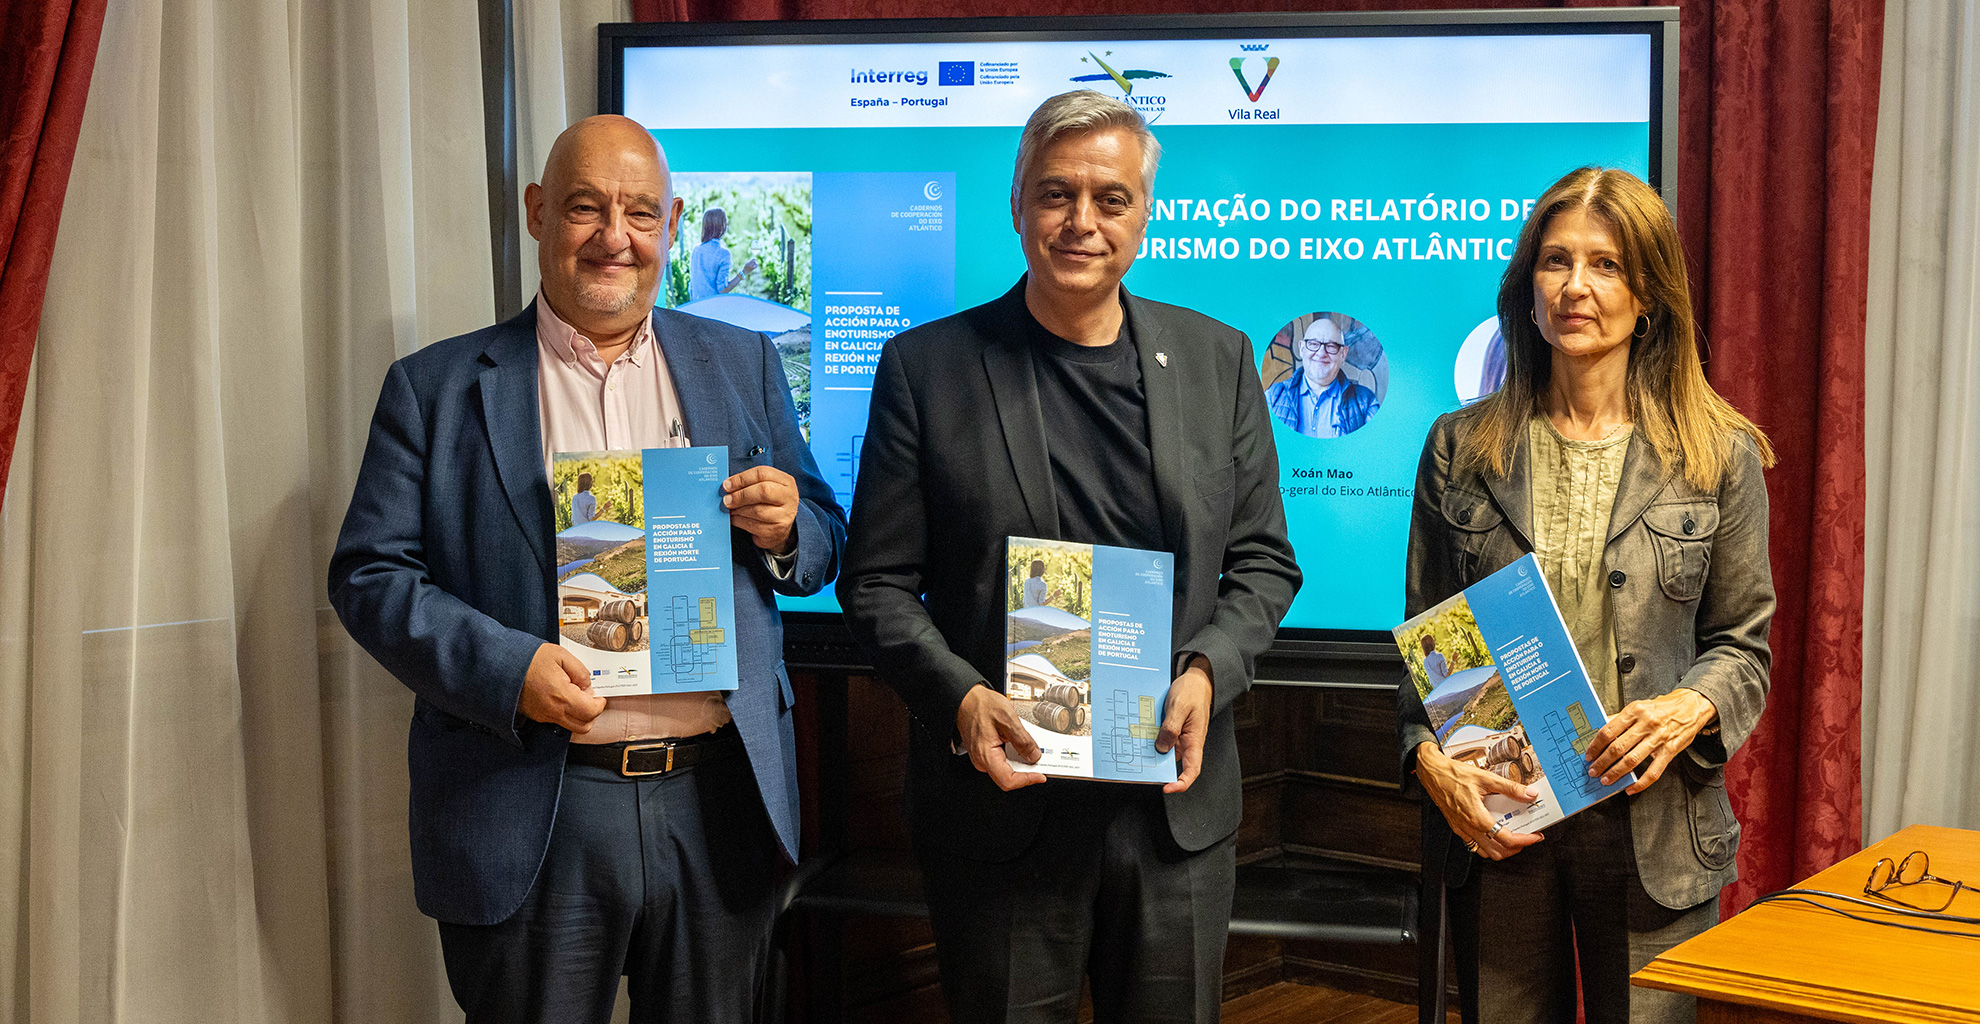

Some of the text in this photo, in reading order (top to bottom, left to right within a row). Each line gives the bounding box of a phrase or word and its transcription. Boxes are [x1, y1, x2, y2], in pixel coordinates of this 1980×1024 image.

[851, 68, 928, 86] Interreg
[851, 97, 890, 108] España
[901, 97, 948, 108] Portugal
[1228, 108, 1280, 120] Vila Real
[1281, 199, 1321, 221] DO
[1331, 192, 1491, 221] RELATÓRIO
[1249, 237, 1290, 260] DO
[1300, 237, 1364, 260] EIXO
[1372, 231, 1515, 261] ATLÂNTIC
[825, 305, 900, 315] PROPOSTA DE
[825, 315, 911, 327] ACCIÓN PARA O
[825, 329, 896, 339] ENOTURISMO
[825, 341, 883, 351] EN GALICIA
[825, 351, 865, 363] REXIÓN
[825, 365, 839, 374] DE
[1292, 467, 1353, 479] Xoán Mao
[1321, 485, 1337, 496] do
[1340, 486, 1364, 496] Eixo
[653, 529, 678, 537] ACCIÓN
[1098, 618, 1134, 627] PROPOSTAS
[1098, 631, 1137, 641] ENOTURISMO
[1123, 627, 1139, 635] PARA
[1107, 638, 1131, 647] GALICIA
[1121, 646, 1141, 654] NORTE
[1500, 636, 1539, 661] PROPOSTAS DE
[1523, 645, 1539, 656] PARA
[1107, 651, 1138, 660] PORTUGAL
[1505, 651, 1539, 673] ENOTURISMO
[1508, 671, 1516, 679] EN
[1516, 661, 1537, 674] GALICIA
[1530, 661, 1549, 675] NORTE
[1513, 669, 1549, 692] DE PORTUGAL
